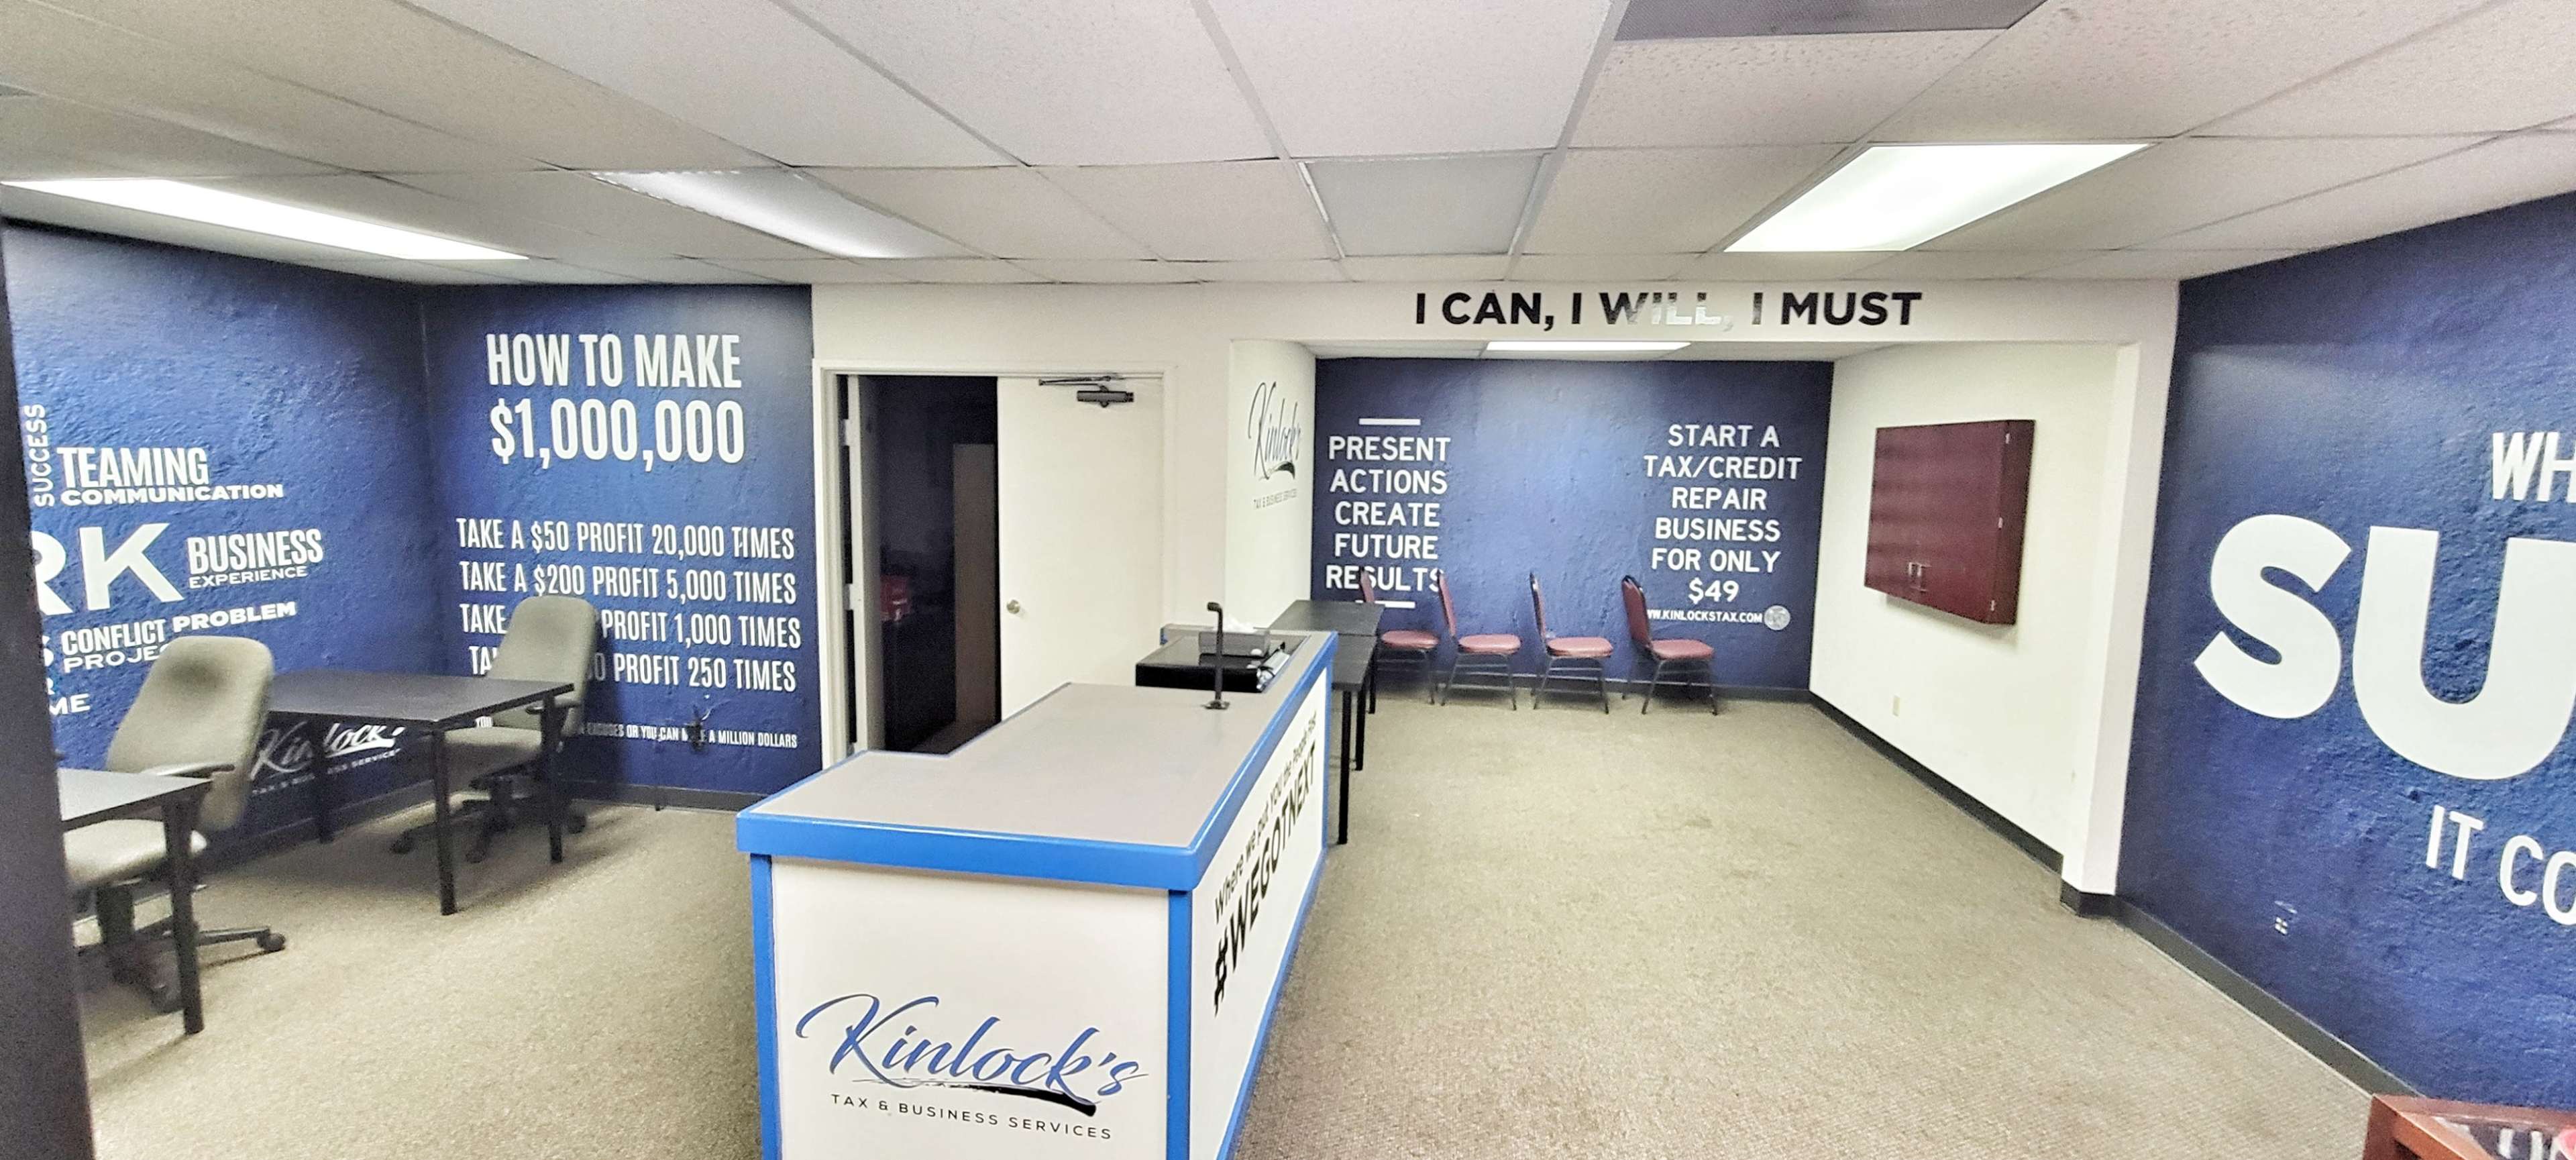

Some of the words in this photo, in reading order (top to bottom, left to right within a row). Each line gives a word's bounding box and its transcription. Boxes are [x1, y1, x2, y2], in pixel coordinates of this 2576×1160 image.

[1416, 293, 1425, 325] I
[1442, 292, 1554, 332] CAN,
[1572, 293, 1581, 325] I
[1752, 293, 1762, 325] I
[1782, 292, 1923, 325] MUST
[486, 333, 570, 387] HOW
[579, 333, 622, 387] TO
[635, 333, 742, 388] MAKE
[490, 397, 744, 472] $1,000,000
[1329, 436, 1451, 462] PRESENT
[1668, 424, 1753, 447] START
[1760, 425, 1780, 448] A
[23, 403, 55, 507] SUCCESS
[57, 447, 209, 489] TEAMING
[1644, 455, 1803, 480] TAX/CREDIT
[61, 483, 283, 506] COMMUNICATION
[1330, 469, 1448, 495] ACTIONS
[1672, 487, 1768, 511] REPAIR
[1335, 501, 1440, 527] CREATE
[1655, 517, 1781, 542] BUSINESS
[188, 529, 323, 574] BUSINESS
[456, 517, 504, 549] TAKE
[511, 520, 525, 549] A
[531, 521, 569, 553] $50
[577, 522, 644, 554] PROFIT
[651, 525, 724, 561] 20,000
[732, 527, 794, 559] TIMES
[1334, 533, 1438, 560] FUTURE
[189, 566, 307, 589] EXPERIENCE
[1326, 566, 1445, 592] RESULTS
[1651, 548, 1701, 570] FOR
[1710, 549, 1780, 572] ONLY
[460, 561, 506, 592] TAKE
[514, 563, 527, 593] A
[534, 564, 585, 596] $200
[592, 566, 659, 598] PROFIT
[666, 569, 727, 604] 5,000
[733, 570, 796, 604] TIMES
[1688, 578, 1739, 604] $49
[61, 619, 166, 656] CONFLICT
[173, 601, 297, 633] PROBLEM
[460, 603, 508, 635] TAKE
[602, 609, 669, 642] PROFIT
[674, 613, 732, 648] 1,000
[737, 616, 801, 649] TIMES
[614, 652, 680, 685] PROFIT
[688, 657, 727, 688] 250
[733, 659, 796, 692] TIMES
[626, 724, 638, 739] OR
[640, 725, 657, 740] YOU
[659, 727, 679, 741] CAN
[708, 730, 716, 743] A
[718, 730, 755, 746] MILLION
[757, 732, 798, 749] DOLLARS
[2426, 804, 2485, 880] IT
[1213, 739, 1315, 1017] #WEGOTNEXT
[1214, 854, 1244, 925] Where
[796, 993, 1149, 1104] Kinlock's
[831, 1093, 869, 1110] TAX
[878, 1100, 889, 1112] &
[900, 1102, 999, 1126] BUSINESS
[1008, 1116, 1112, 1141] SERVICES
